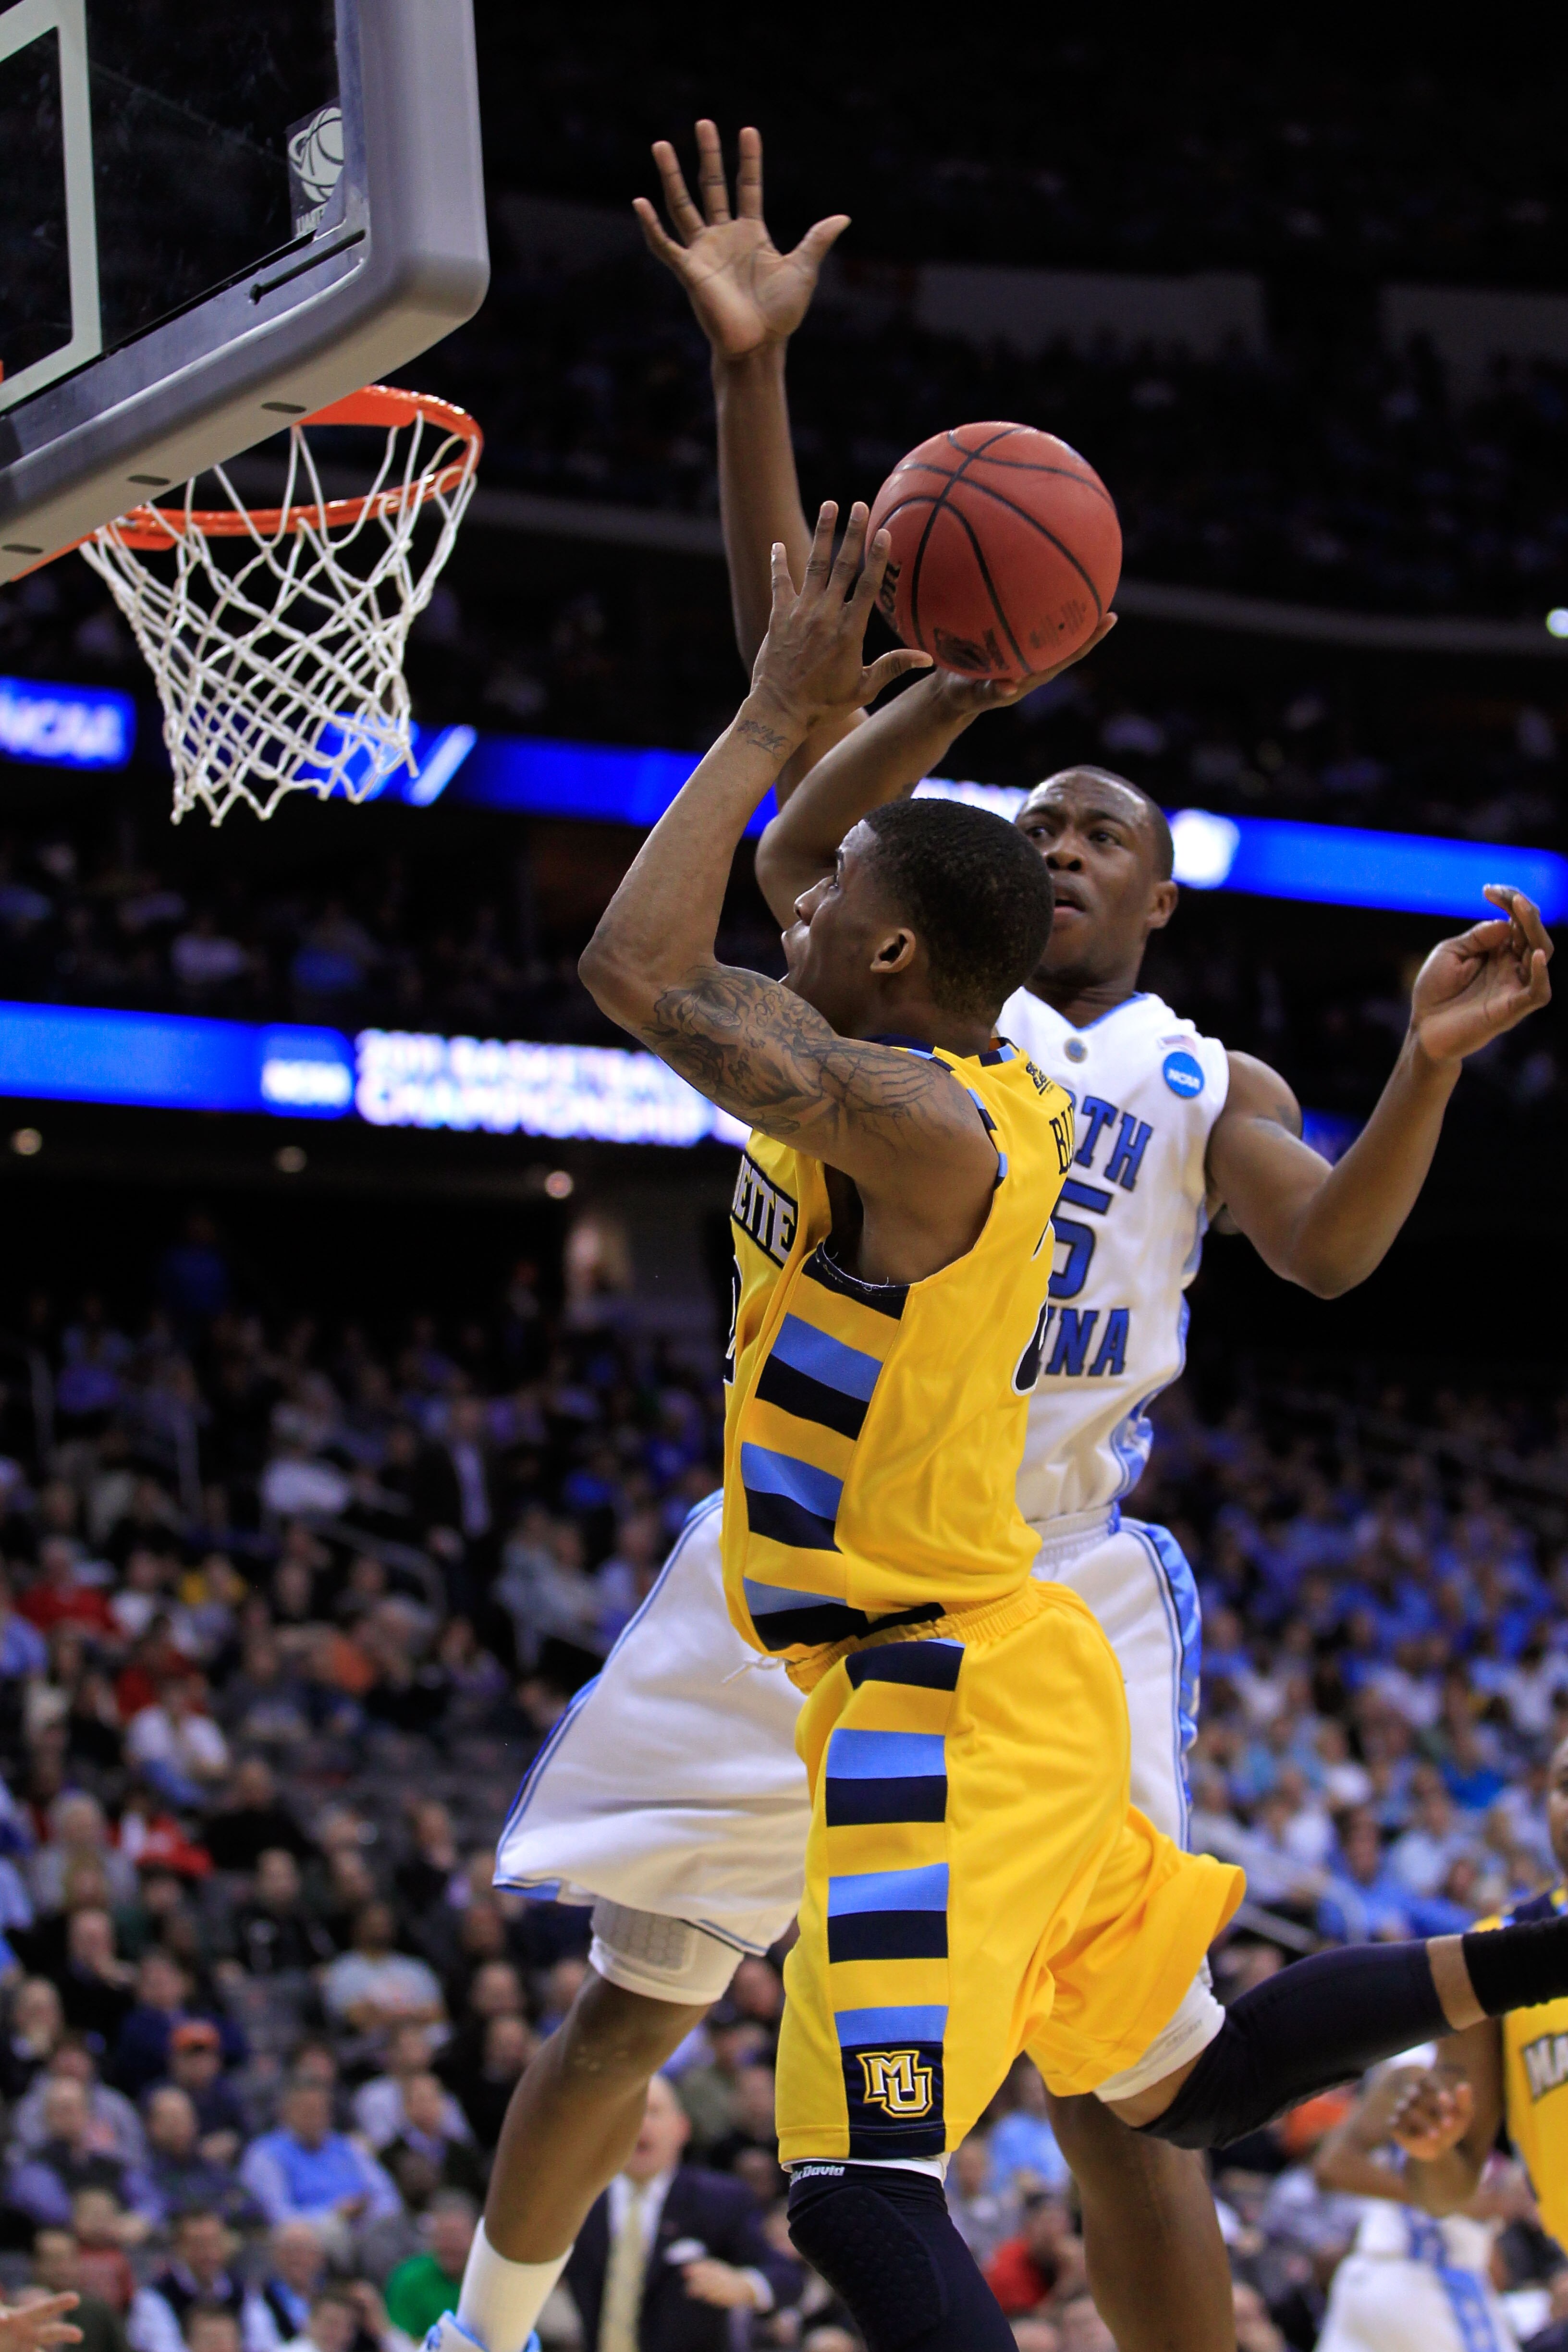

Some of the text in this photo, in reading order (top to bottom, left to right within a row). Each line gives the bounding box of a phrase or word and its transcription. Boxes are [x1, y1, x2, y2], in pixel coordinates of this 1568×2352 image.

[1168, 1067, 1200, 1090] NCAA
[1064, 1087, 1154, 1192] TH
[1047, 1178, 1114, 1299] 5
[865, 2053, 930, 2115] MU
